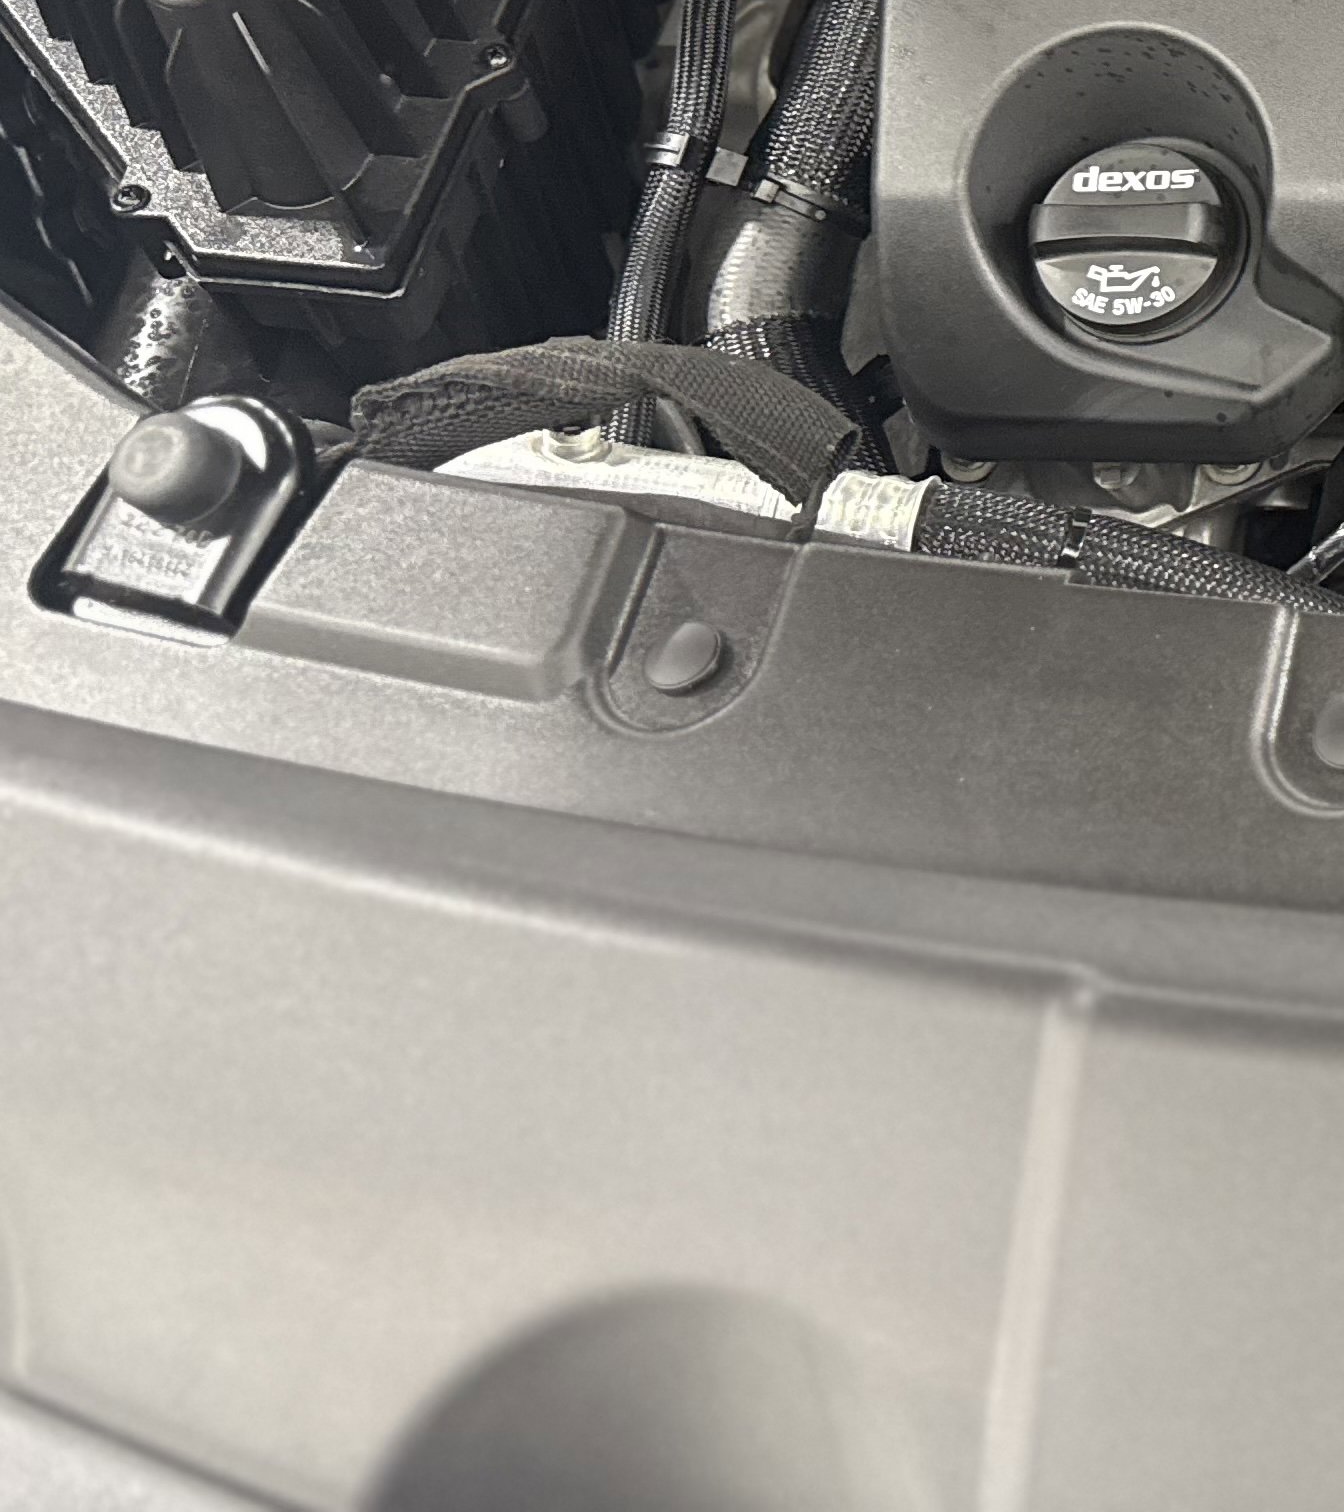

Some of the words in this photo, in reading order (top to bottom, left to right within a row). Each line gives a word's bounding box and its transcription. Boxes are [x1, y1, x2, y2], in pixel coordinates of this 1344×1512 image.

[1072, 165, 1198, 192] dexos
[1071, 287, 1109, 314] SAE
[1112, 286, 1176, 316] 5W-30
